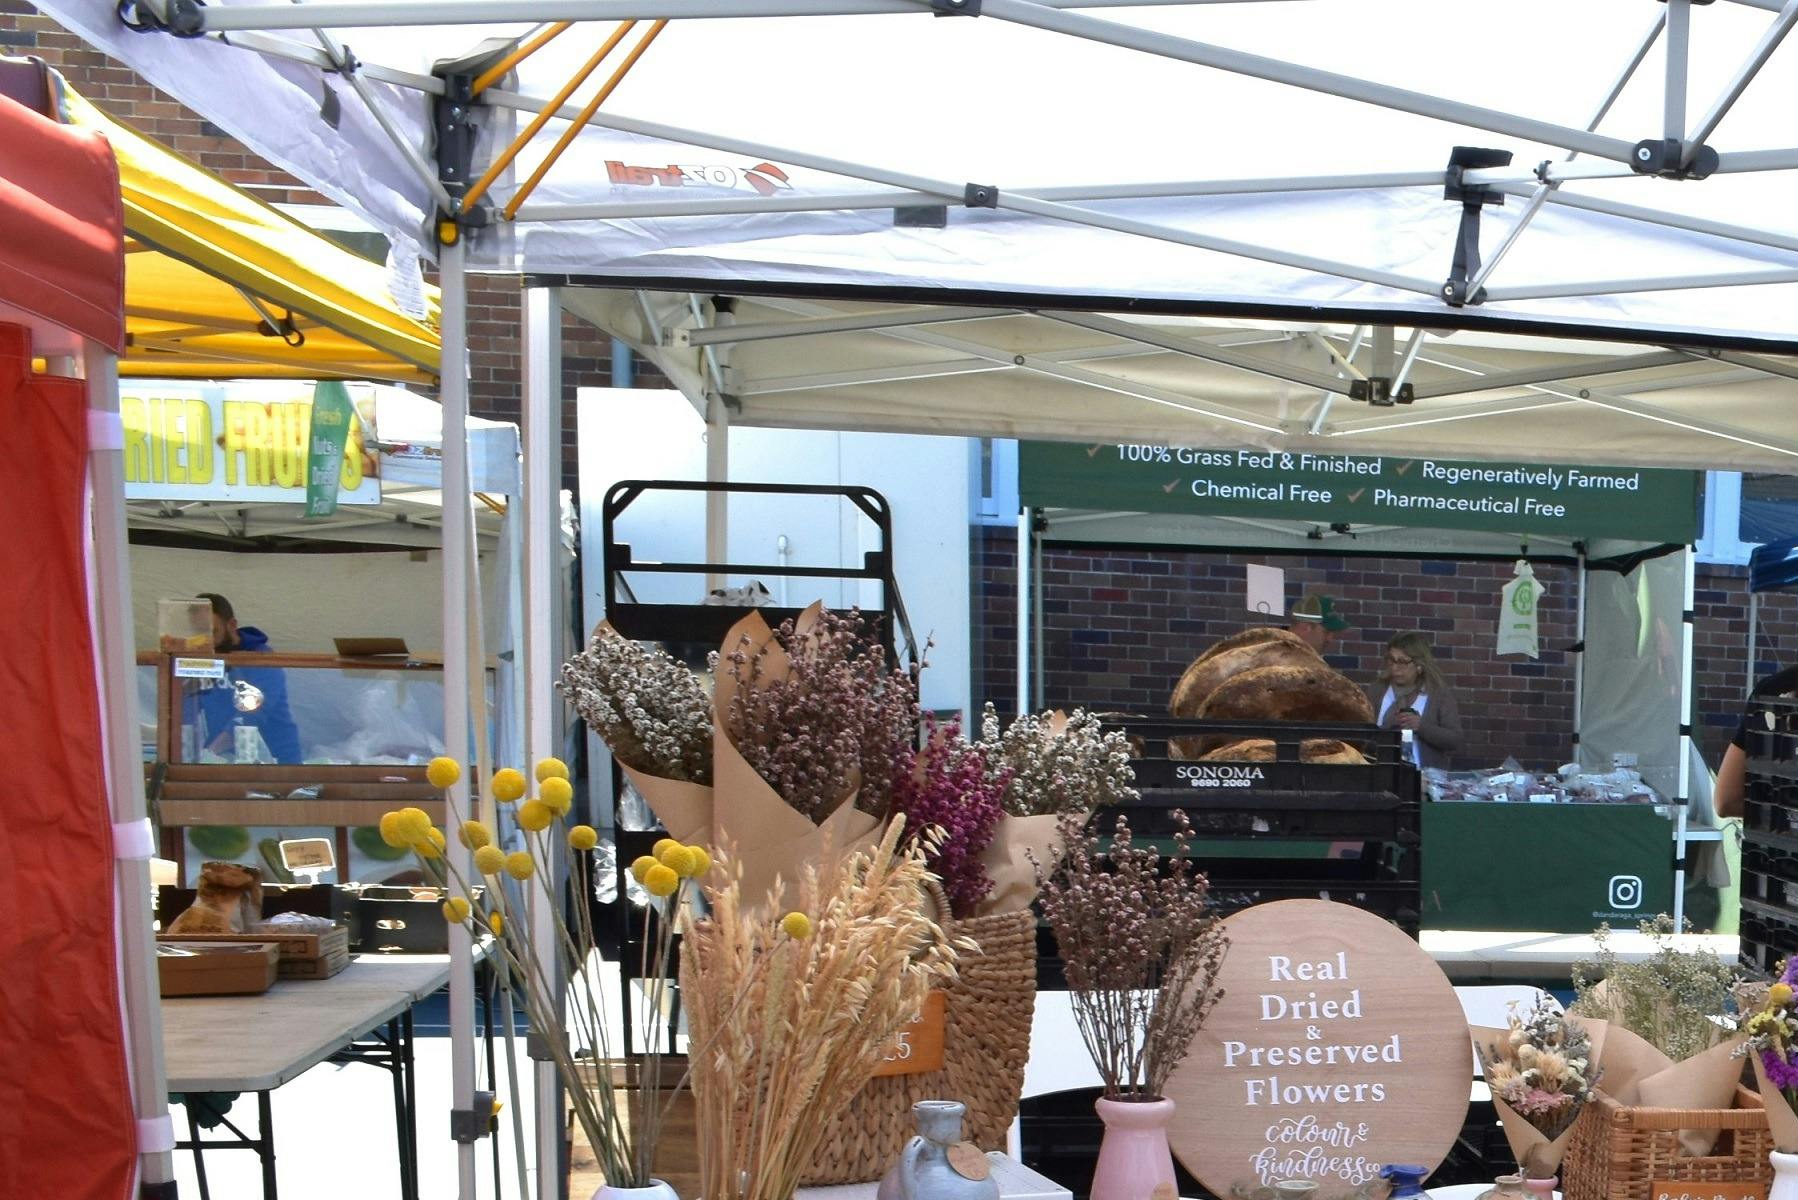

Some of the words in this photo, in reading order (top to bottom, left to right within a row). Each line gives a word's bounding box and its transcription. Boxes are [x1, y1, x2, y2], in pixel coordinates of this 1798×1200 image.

[223, 400, 364, 491] FRUIS
[1117, 444, 1171, 463] 100%
[1176, 448, 1232, 467] Grass
[1237, 450, 1273, 469] Fed
[1280, 454, 1295, 470] &
[1301, 453, 1382, 475] Finished
[1422, 461, 1563, 491] Regeneratively
[1568, 470, 1639, 490] Farmed
[1192, 479, 1284, 501] Chemical
[1290, 484, 1332, 503] Free
[1374, 488, 1518, 514] Pharmaceutical
[1524, 499, 1566, 517] Free
[1176, 766, 1265, 779] SONOMA
[1222, 779, 1251, 787] 2060
[1268, 951, 1349, 982] Real
[1259, 989, 1363, 1021] Dried
[1306, 1025, 1322, 1040] &
[1222, 1034, 1402, 1067] Preserved
[1244, 1076, 1386, 1106] Flowers
[1265, 1115, 1369, 1147] colour
[1248, 1146, 1374, 1186] kindness
